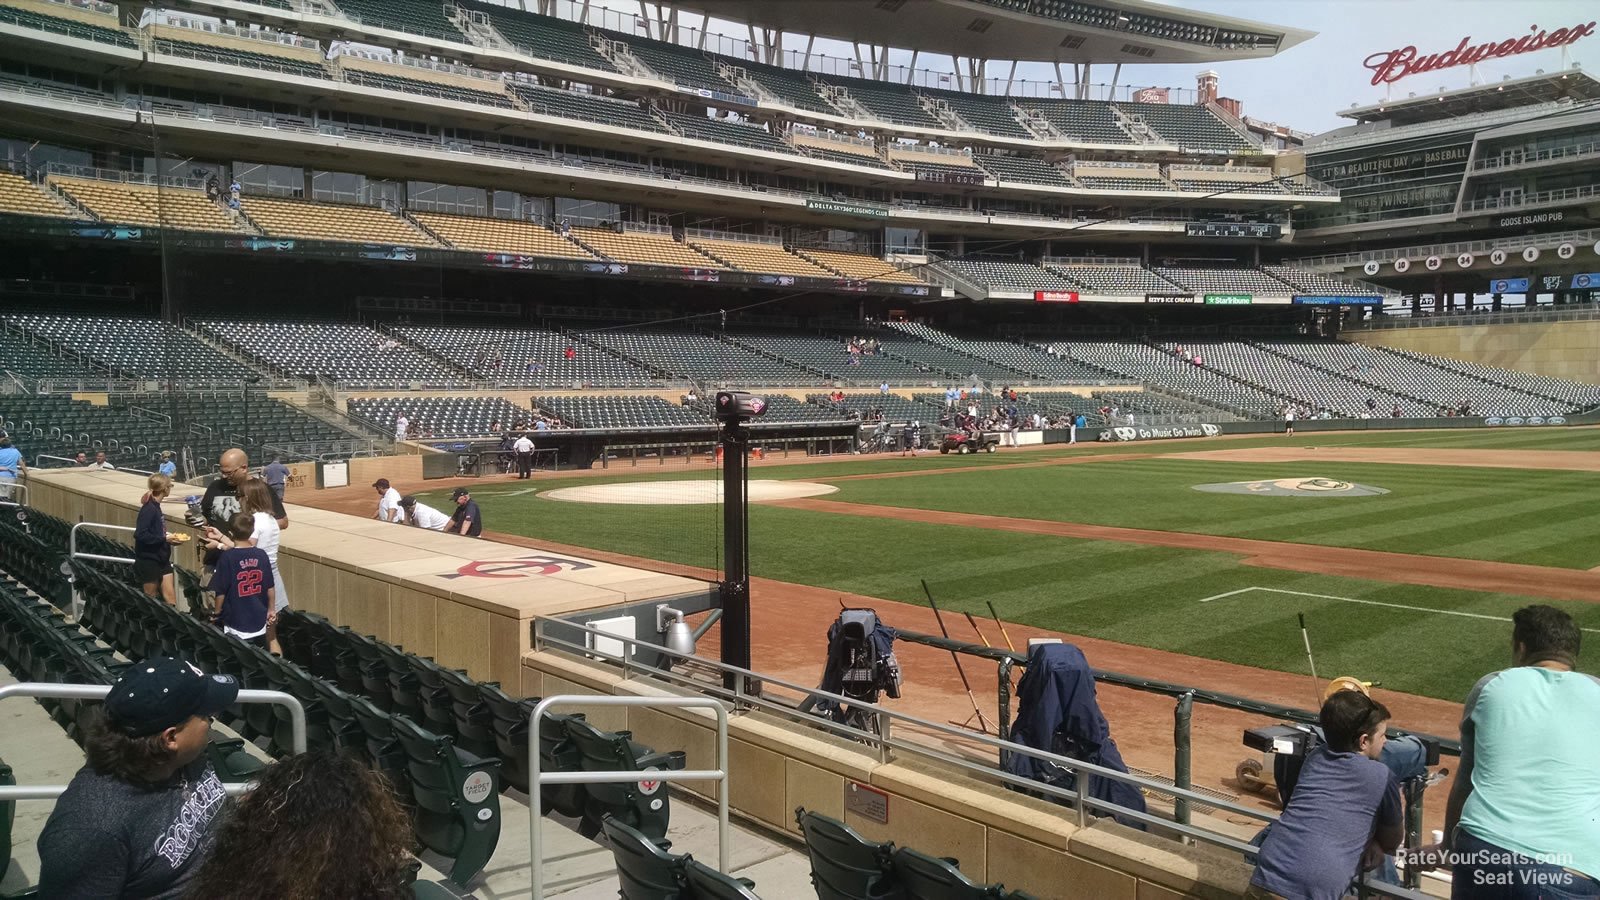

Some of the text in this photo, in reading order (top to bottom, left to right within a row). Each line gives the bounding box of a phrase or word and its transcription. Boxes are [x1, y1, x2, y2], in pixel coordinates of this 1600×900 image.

[1363, 21, 1597, 86] Budweiser
[1322, 166, 1339, 178] IT'S
[1340, 165, 1347, 175] A
[1348, 159, 1392, 174] BEAUTIFUL
[1394, 156, 1409, 168] DAY
[1425, 148, 1467, 163] BASEBALL
[1354, 198, 1369, 208] THIS
[1370, 197, 1378, 206] IS
[1379, 193, 1409, 207] TWINS
[814, 202, 833, 210] DELTA
[853, 207, 875, 215] LEGENDS
[1500, 212, 1563, 227] GOOSE ISLAND PUB
[1528, 250, 1533, 258] 6
[1560, 247, 1571, 256] 29
[1460, 256, 1470, 264] 34
[1494, 253, 1502, 262] 14
[1398, 261, 1406, 269] 10
[1214, 296, 1250, 304] StarTribune
[1139, 429, 1151, 438] Go
[1152, 428, 1172, 438] Music
[1173, 427, 1184, 437] Go
[1184, 426, 1202, 436] Twins
[237, 569, 262, 597] 22
[465, 782, 490, 791] TARGET
[468, 787, 487, 795] FIELD
[159, 770, 226, 869] ROCKIES
